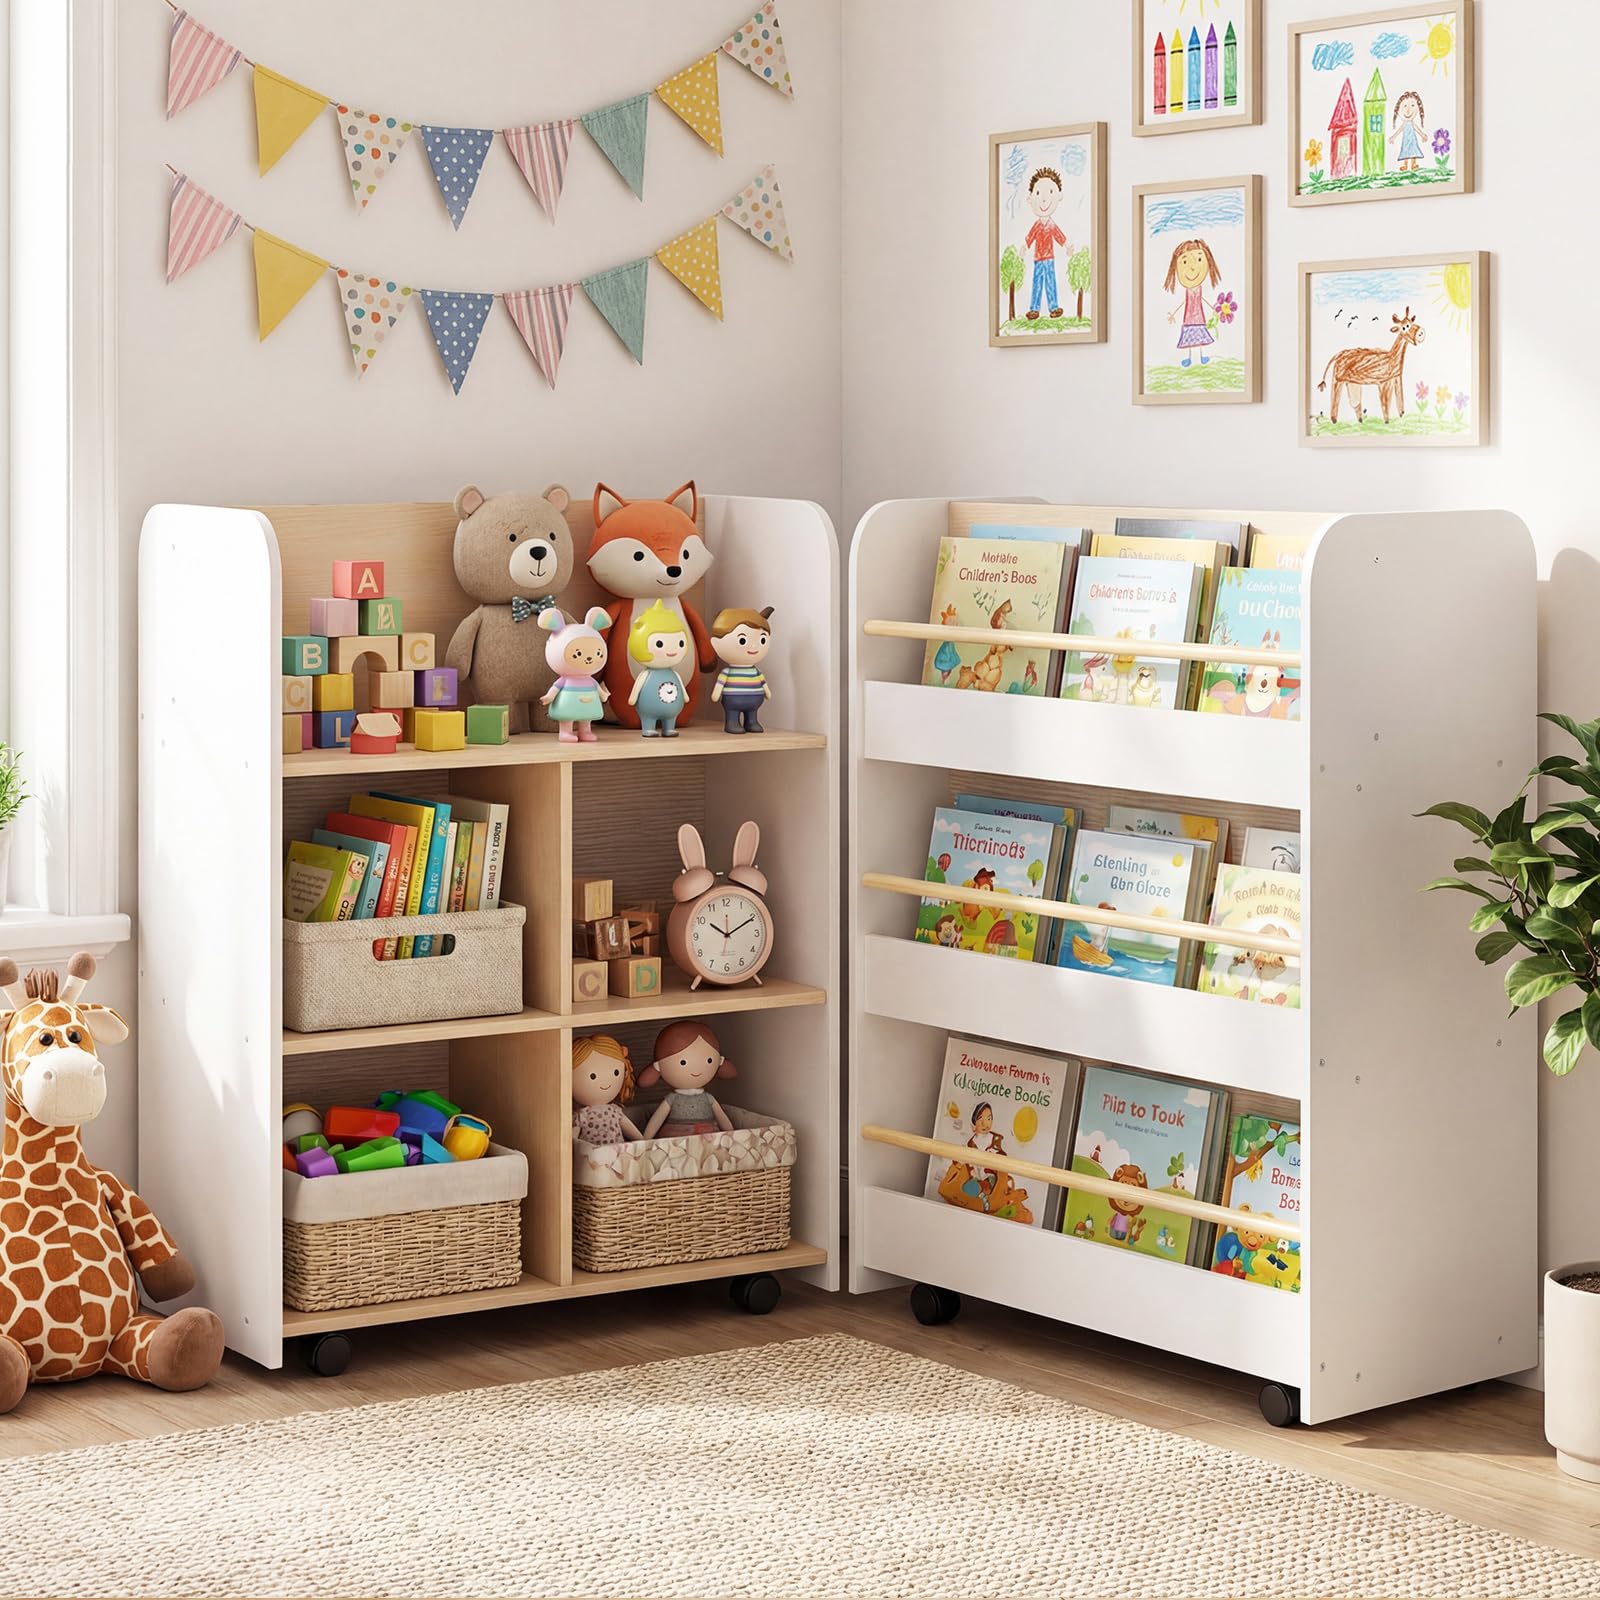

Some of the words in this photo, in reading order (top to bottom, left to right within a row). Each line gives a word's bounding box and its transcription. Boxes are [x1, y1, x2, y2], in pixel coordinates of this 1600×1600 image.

[357, 567, 379, 594] A
[302, 642, 323, 669] B
[409, 639, 429, 664] C
[287, 680, 305, 707] C
[722, 897, 731, 907] 12
[707, 903, 716, 912] 11
[696, 916, 706, 925] 10
[693, 932, 699, 941] 9
[754, 929, 760, 938] 3
[697, 948, 703, 957] 8
[750, 945, 756, 953] 4
[709, 959, 715, 968] 7
[738, 957, 745, 966] 5
[724, 962, 730, 972] 6
[578, 969, 601, 996] C
[635, 965, 657, 992] D
[1130, 1102, 1146, 1119] to
